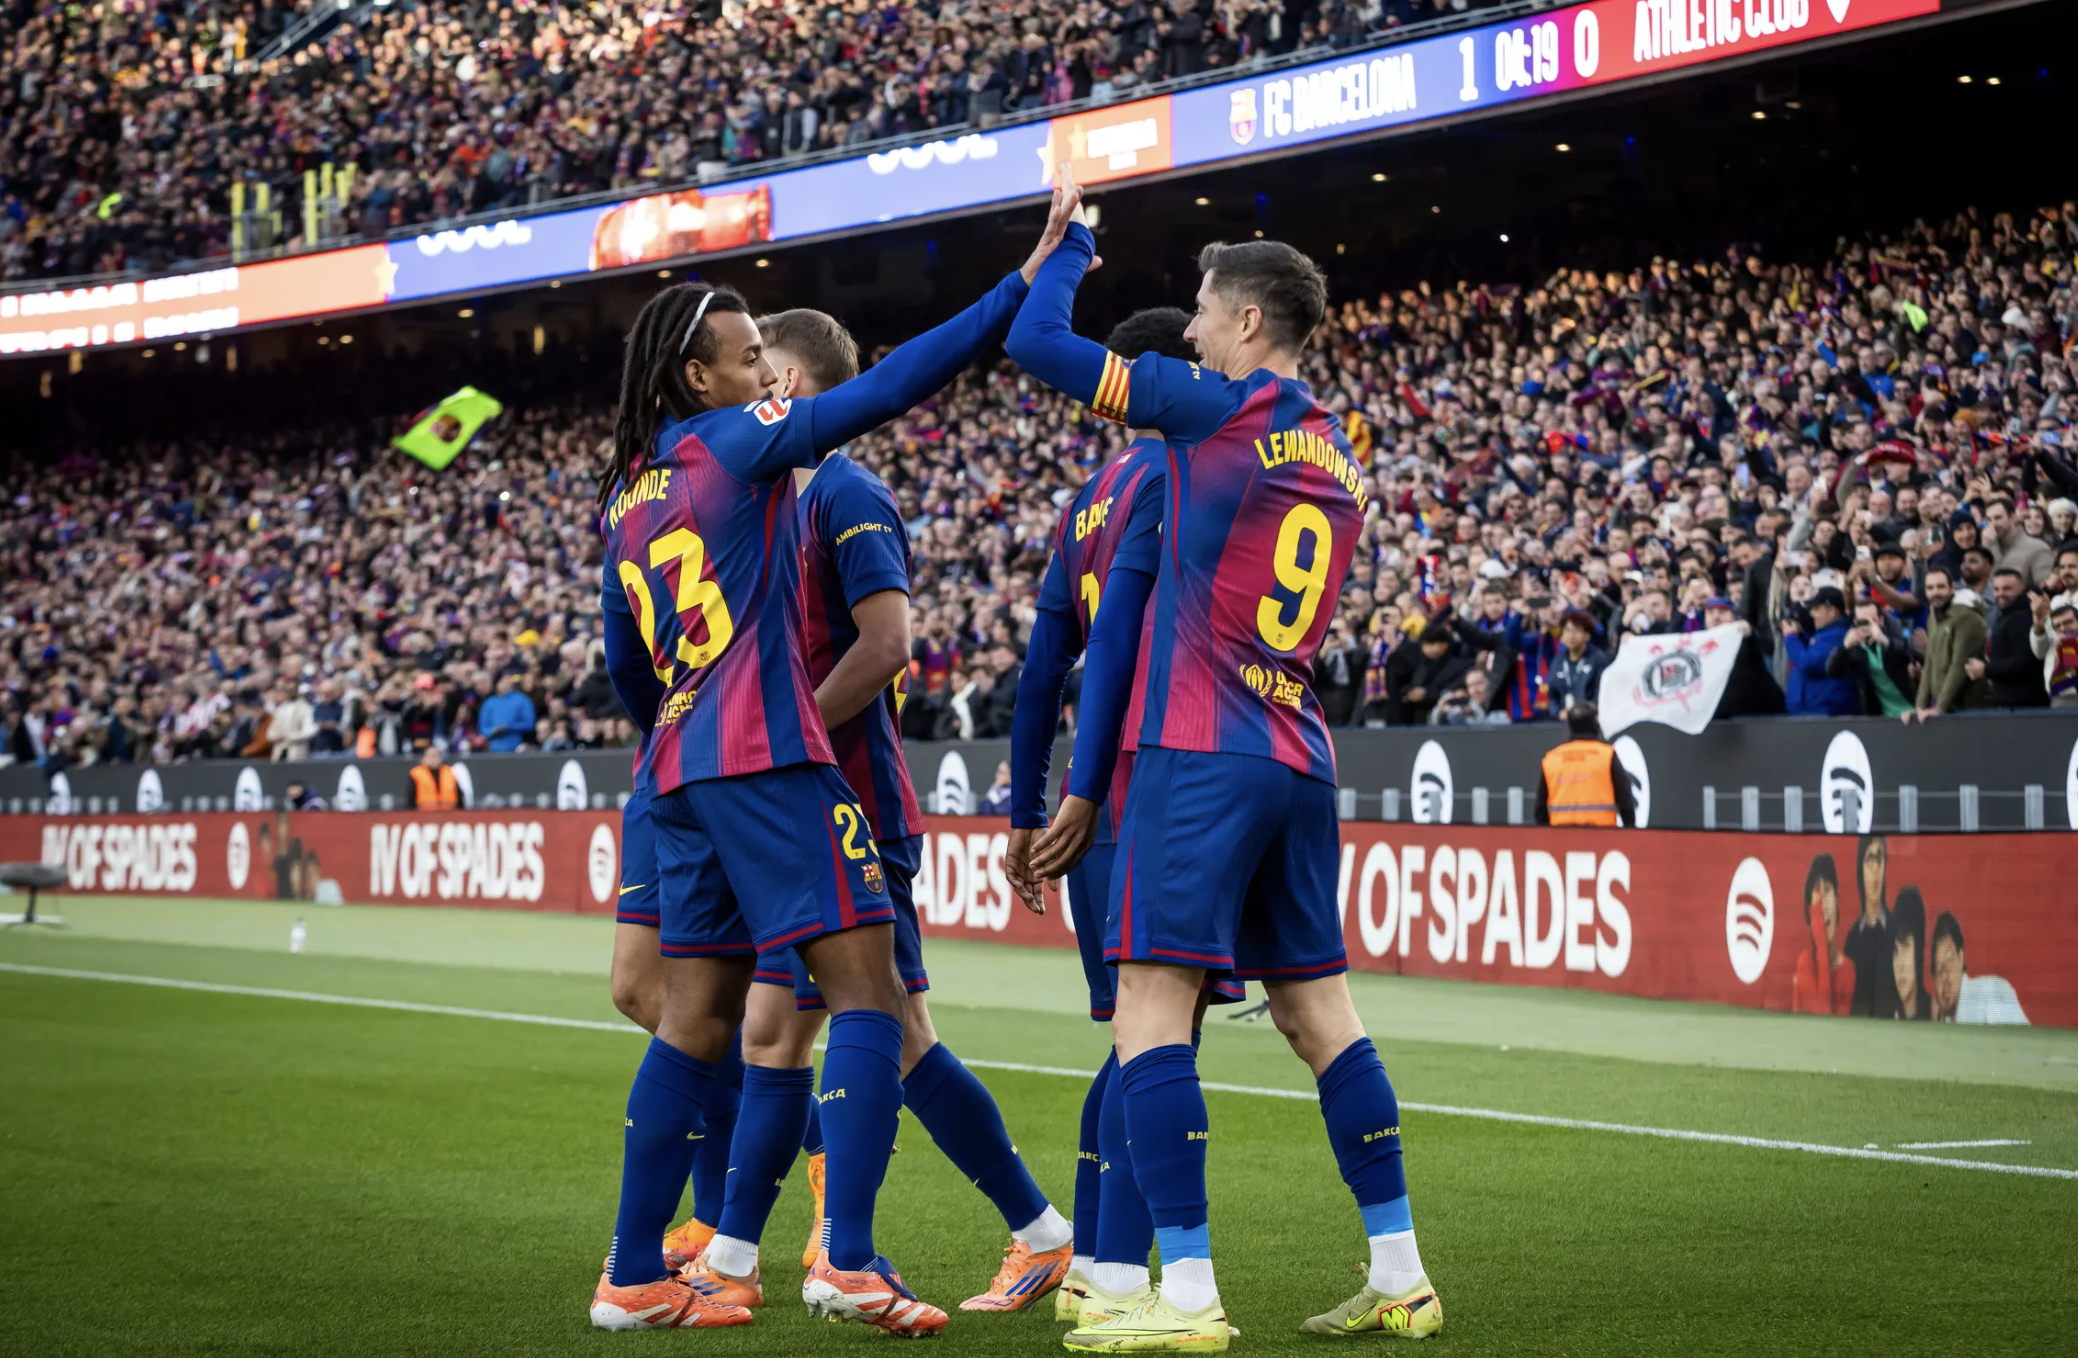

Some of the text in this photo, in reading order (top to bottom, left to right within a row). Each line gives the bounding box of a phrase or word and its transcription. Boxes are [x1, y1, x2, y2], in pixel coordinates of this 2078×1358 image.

[1459, 37, 1478, 101] 1
[1495, 21, 1559, 91] 04:19
[1574, 9, 1599, 77] 0
[1264, 80, 1291, 138] FC
[609, 468, 672, 531] KOUNDE
[835, 522, 882, 546] AMBILIGHT
[618, 527, 735, 688] 23
[1256, 503, 1333, 652] 9
[101, 822, 198, 892] SPADES
[436, 820, 546, 903] SPADES
[833, 803, 880, 860] 2
[912, 831, 1013, 932] ADES
[1428, 844, 1632, 979] SPADES
